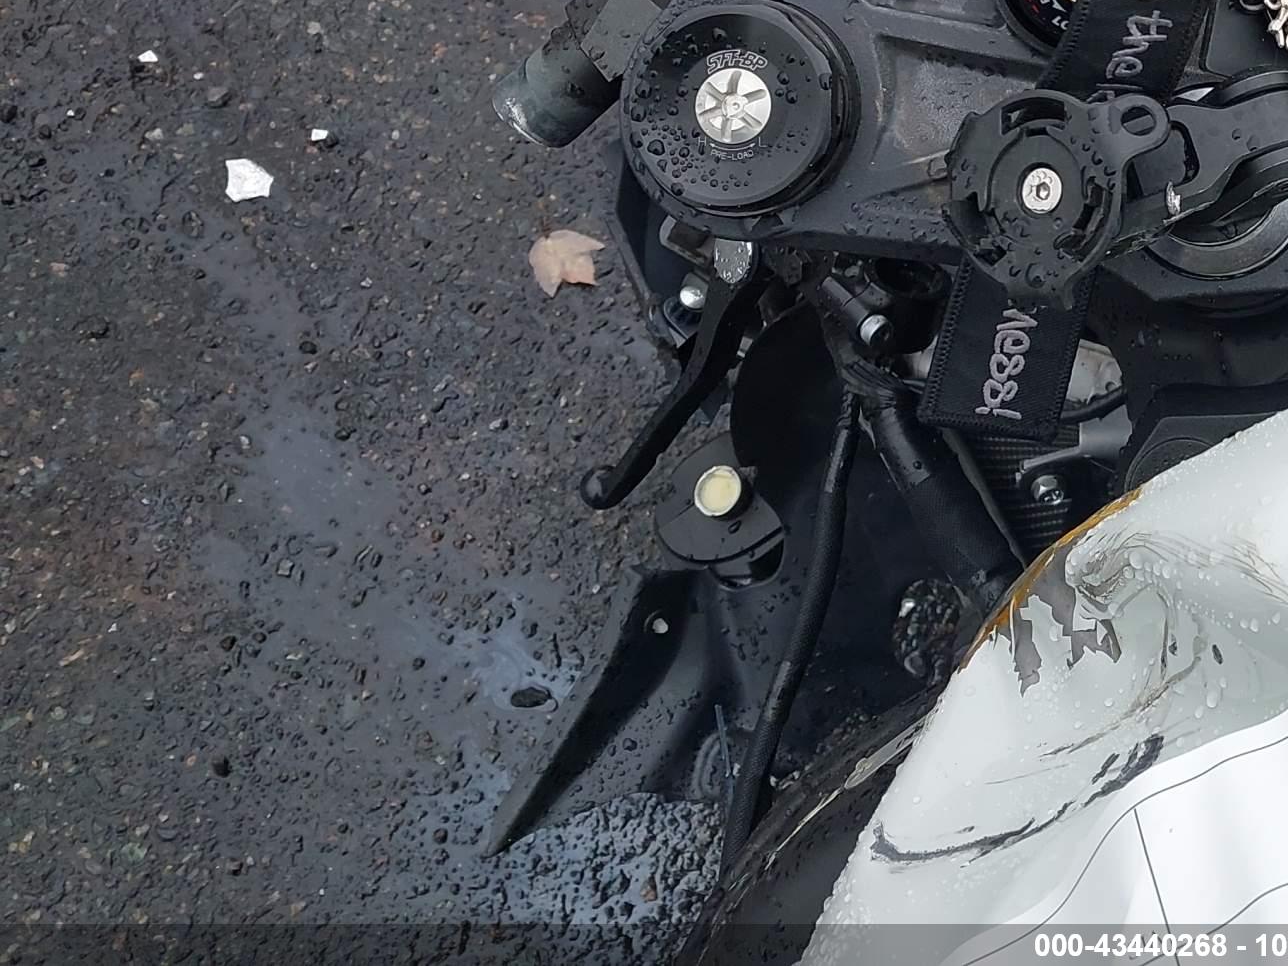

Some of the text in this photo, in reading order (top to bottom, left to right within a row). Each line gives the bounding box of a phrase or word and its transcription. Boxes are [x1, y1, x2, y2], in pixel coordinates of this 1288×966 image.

[1105, 9, 1173, 79] the
[698, 136, 767, 147] H L
[711, 149, 754, 161] PRE-LOAD
